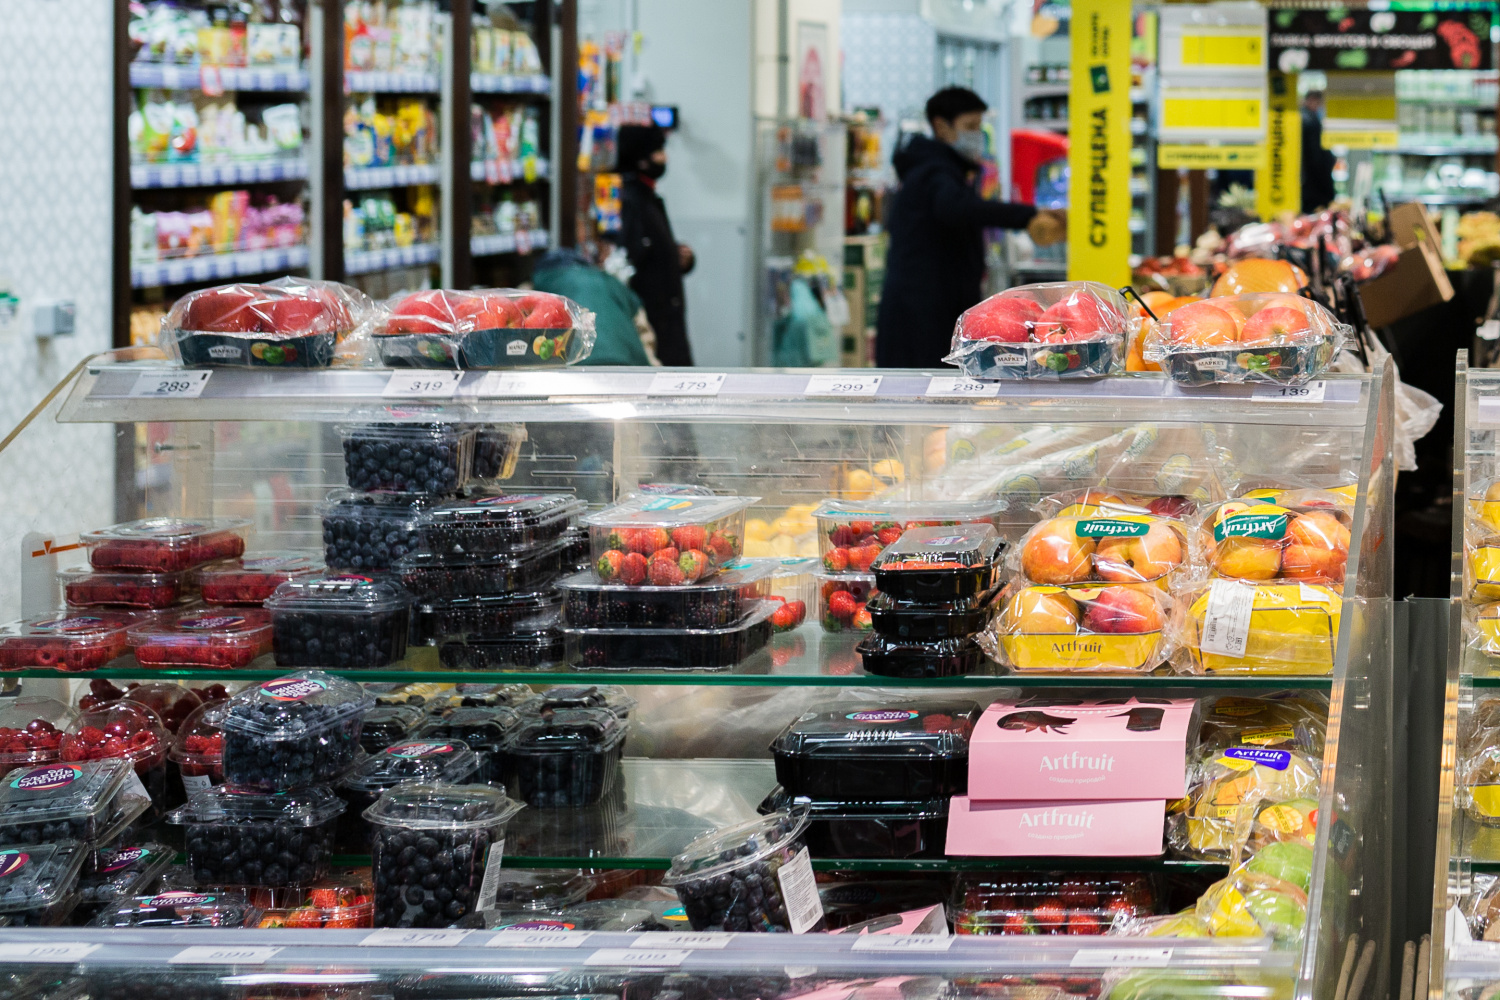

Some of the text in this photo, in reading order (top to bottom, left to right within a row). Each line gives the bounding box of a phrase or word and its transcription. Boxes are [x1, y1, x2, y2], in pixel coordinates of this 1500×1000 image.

[156, 381, 190, 393] 289
[410, 381, 443, 391] 319
[674, 381, 707, 391] 479
[831, 382, 864, 392] 299
[952, 382, 985, 392] 289
[1277, 387, 1310, 397] 139
[1083, 522, 1140, 536] Artfruit
[1221, 518, 1277, 536] Artfruit
[1050, 640, 1102, 656] Artfruit
[1233, 749, 1284, 760] Artfruit
[1039, 751, 1116, 773] Artfruit
[1048, 774, 1106, 785] создано природой
[1018, 808, 1095, 830] Artfruit
